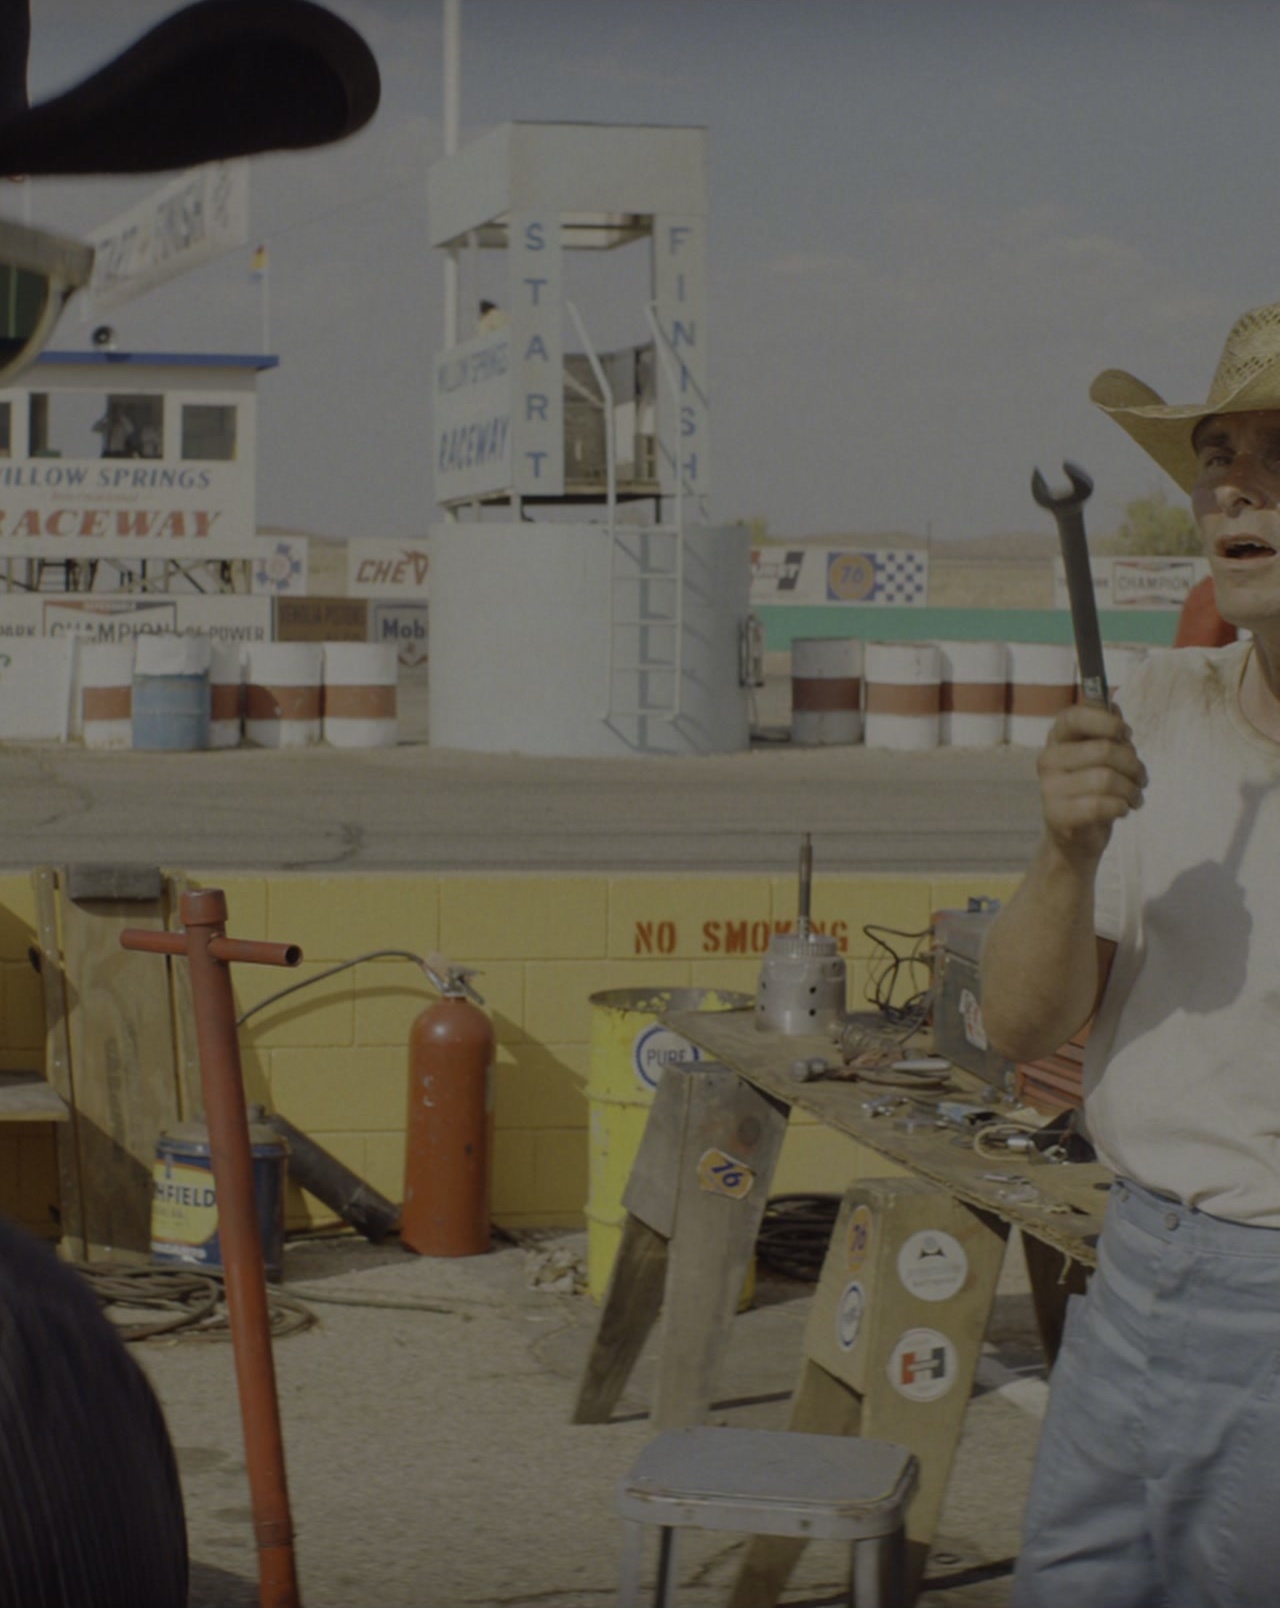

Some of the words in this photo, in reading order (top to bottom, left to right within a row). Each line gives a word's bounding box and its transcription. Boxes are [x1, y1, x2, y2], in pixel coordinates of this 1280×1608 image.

[523, 222, 549, 479] START
[668, 226, 697, 481] FINISH
[438, 416, 510, 474] RACEWAY
[99, 467, 212, 488] SPRINGS
[841, 565, 865, 584] 76
[1118, 576, 1190, 590] CHAMPION
[208, 625, 265, 642] POWER
[382, 618, 426, 639] Mob
[634, 921, 677, 954] NO
[702, 920, 849, 954] SMONG
[646, 1048, 687, 1067] PURE
[711, 1160, 746, 1189] 76
